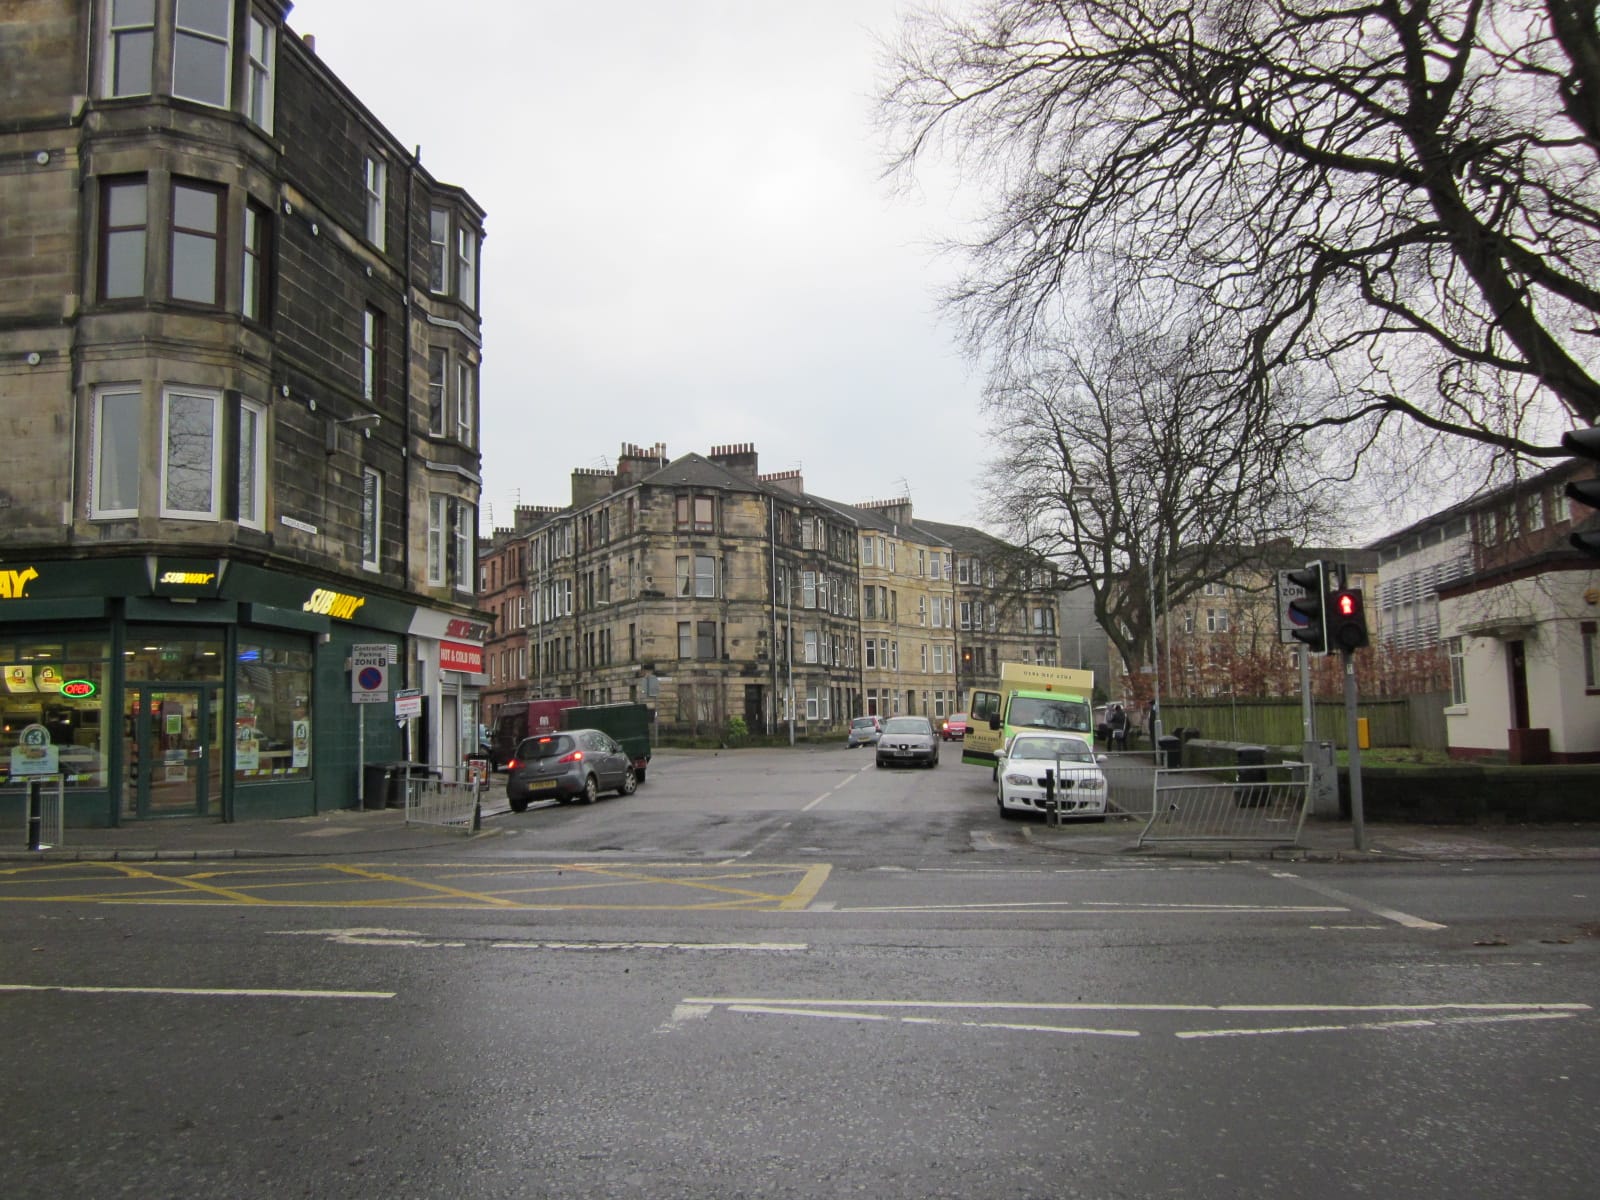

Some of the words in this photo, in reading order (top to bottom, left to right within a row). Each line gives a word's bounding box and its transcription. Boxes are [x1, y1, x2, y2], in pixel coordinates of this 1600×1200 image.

[160, 571, 215, 585] SUBWAY
[303, 588, 365, 619] SUBWAY
[440, 648, 451, 662] HOT
[455, 650, 469, 664] COLD
[469, 652, 481, 665] FOOD
[65, 683, 91, 694] OPEN
